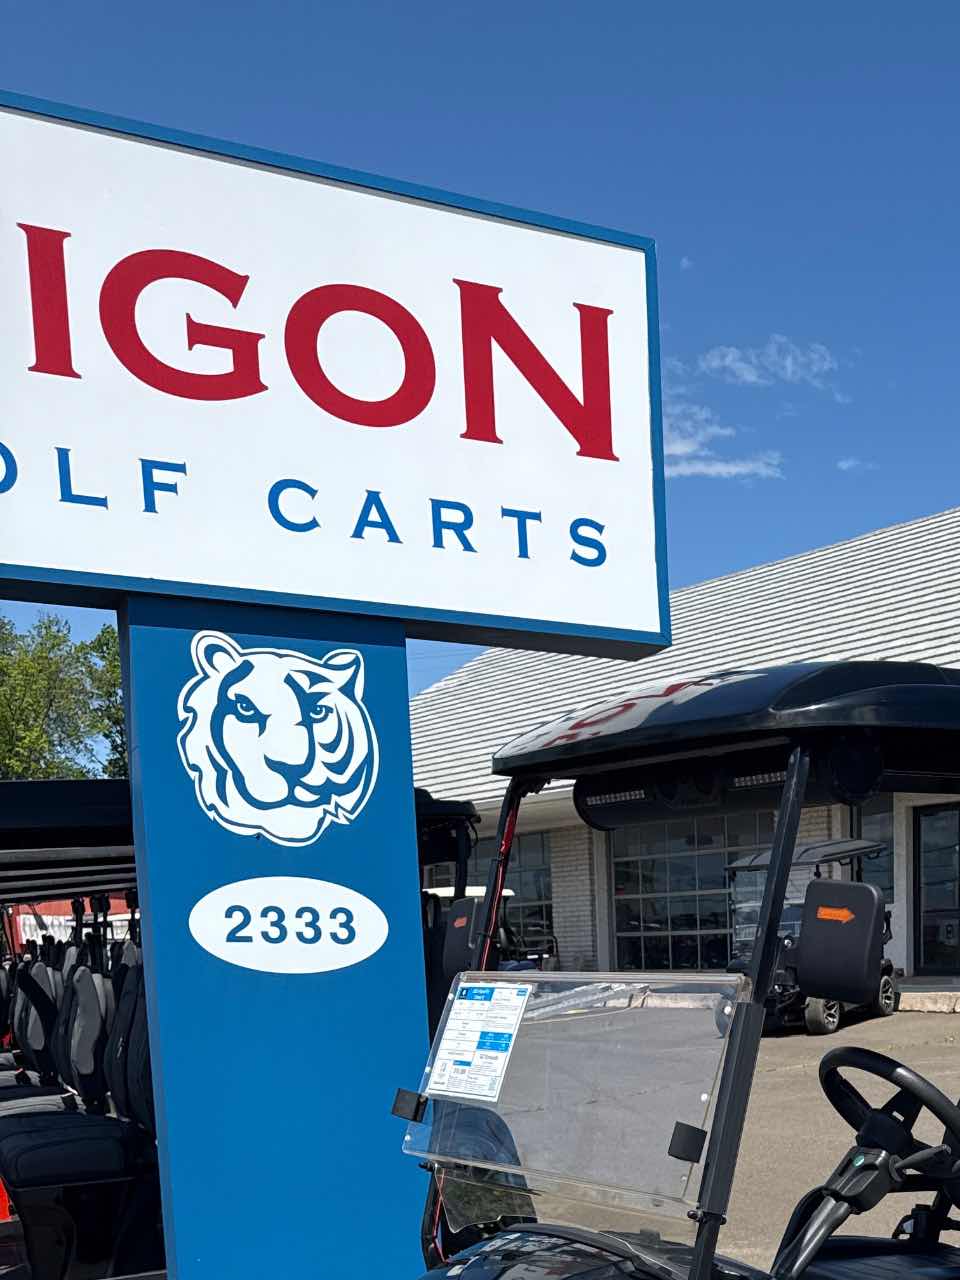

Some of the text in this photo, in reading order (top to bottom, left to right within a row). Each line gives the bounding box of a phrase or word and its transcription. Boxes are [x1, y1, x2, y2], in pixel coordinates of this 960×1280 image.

[16, 222, 620, 461] IGON
[267, 478, 608, 568] CARTS
[224, 904, 356, 945] 2333
